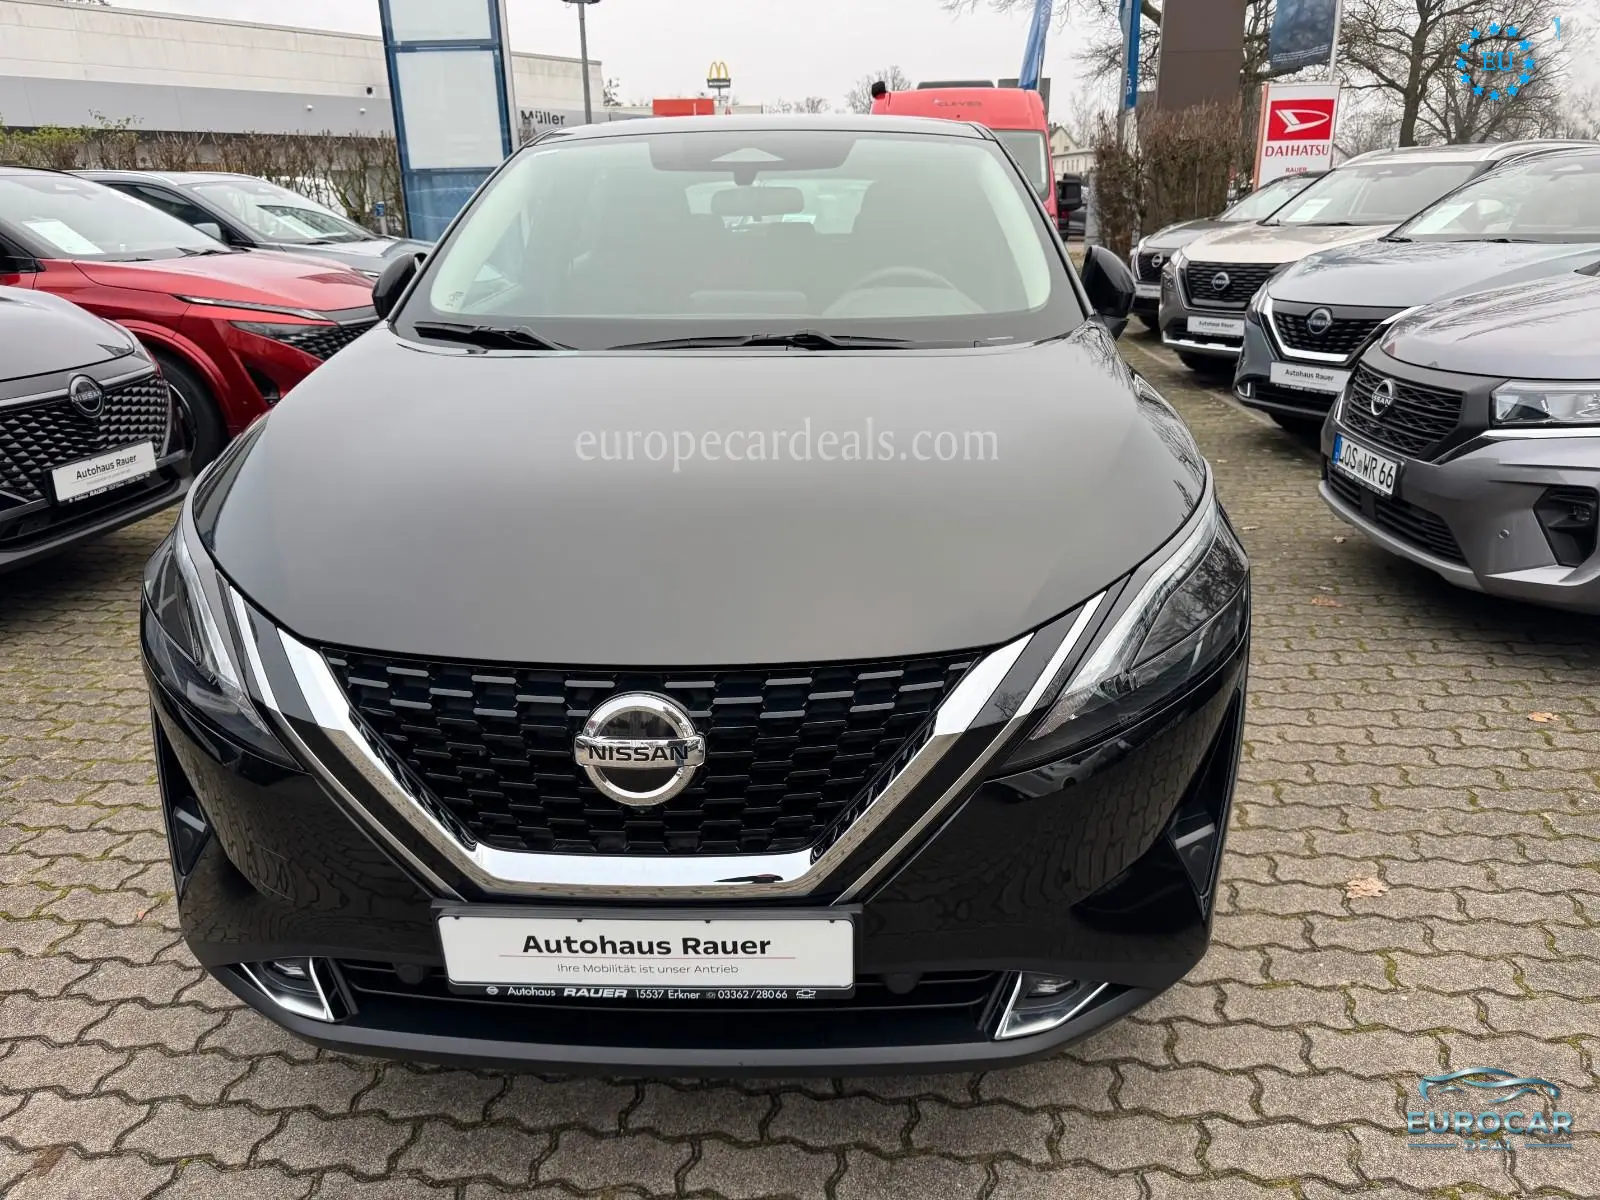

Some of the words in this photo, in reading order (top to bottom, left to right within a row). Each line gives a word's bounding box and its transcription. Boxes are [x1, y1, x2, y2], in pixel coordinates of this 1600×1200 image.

[1265, 144, 1330, 157] DAIHATSU
[1285, 369, 1314, 380] Autohaus
[1315, 373, 1335, 382] Rauer
[76, 463, 115, 480] Autohaus
[116, 454, 137, 467] Rauer
[1339, 439, 1358, 469] LOS
[1362, 453, 1378, 482] WR
[1379, 462, 1394, 489] 66
[588, 745, 689, 761] NISSAN
[523, 935, 672, 955] Autohaus
[681, 937, 771, 955] Rauer
[557, 963, 580, 973] Ihre
[583, 963, 636, 973] Mobilität
[639, 964, 655, 973] ist
[657, 965, 690, 974] unser
[694, 964, 739, 974] Antrieb
[507, 986, 556, 997] Autohaus
[563, 988, 628, 998] RAUER
[635, 990, 665, 999] 15537
[668, 990, 701, 999] Erkner
[717, 990, 788, 999] 03362/28066
